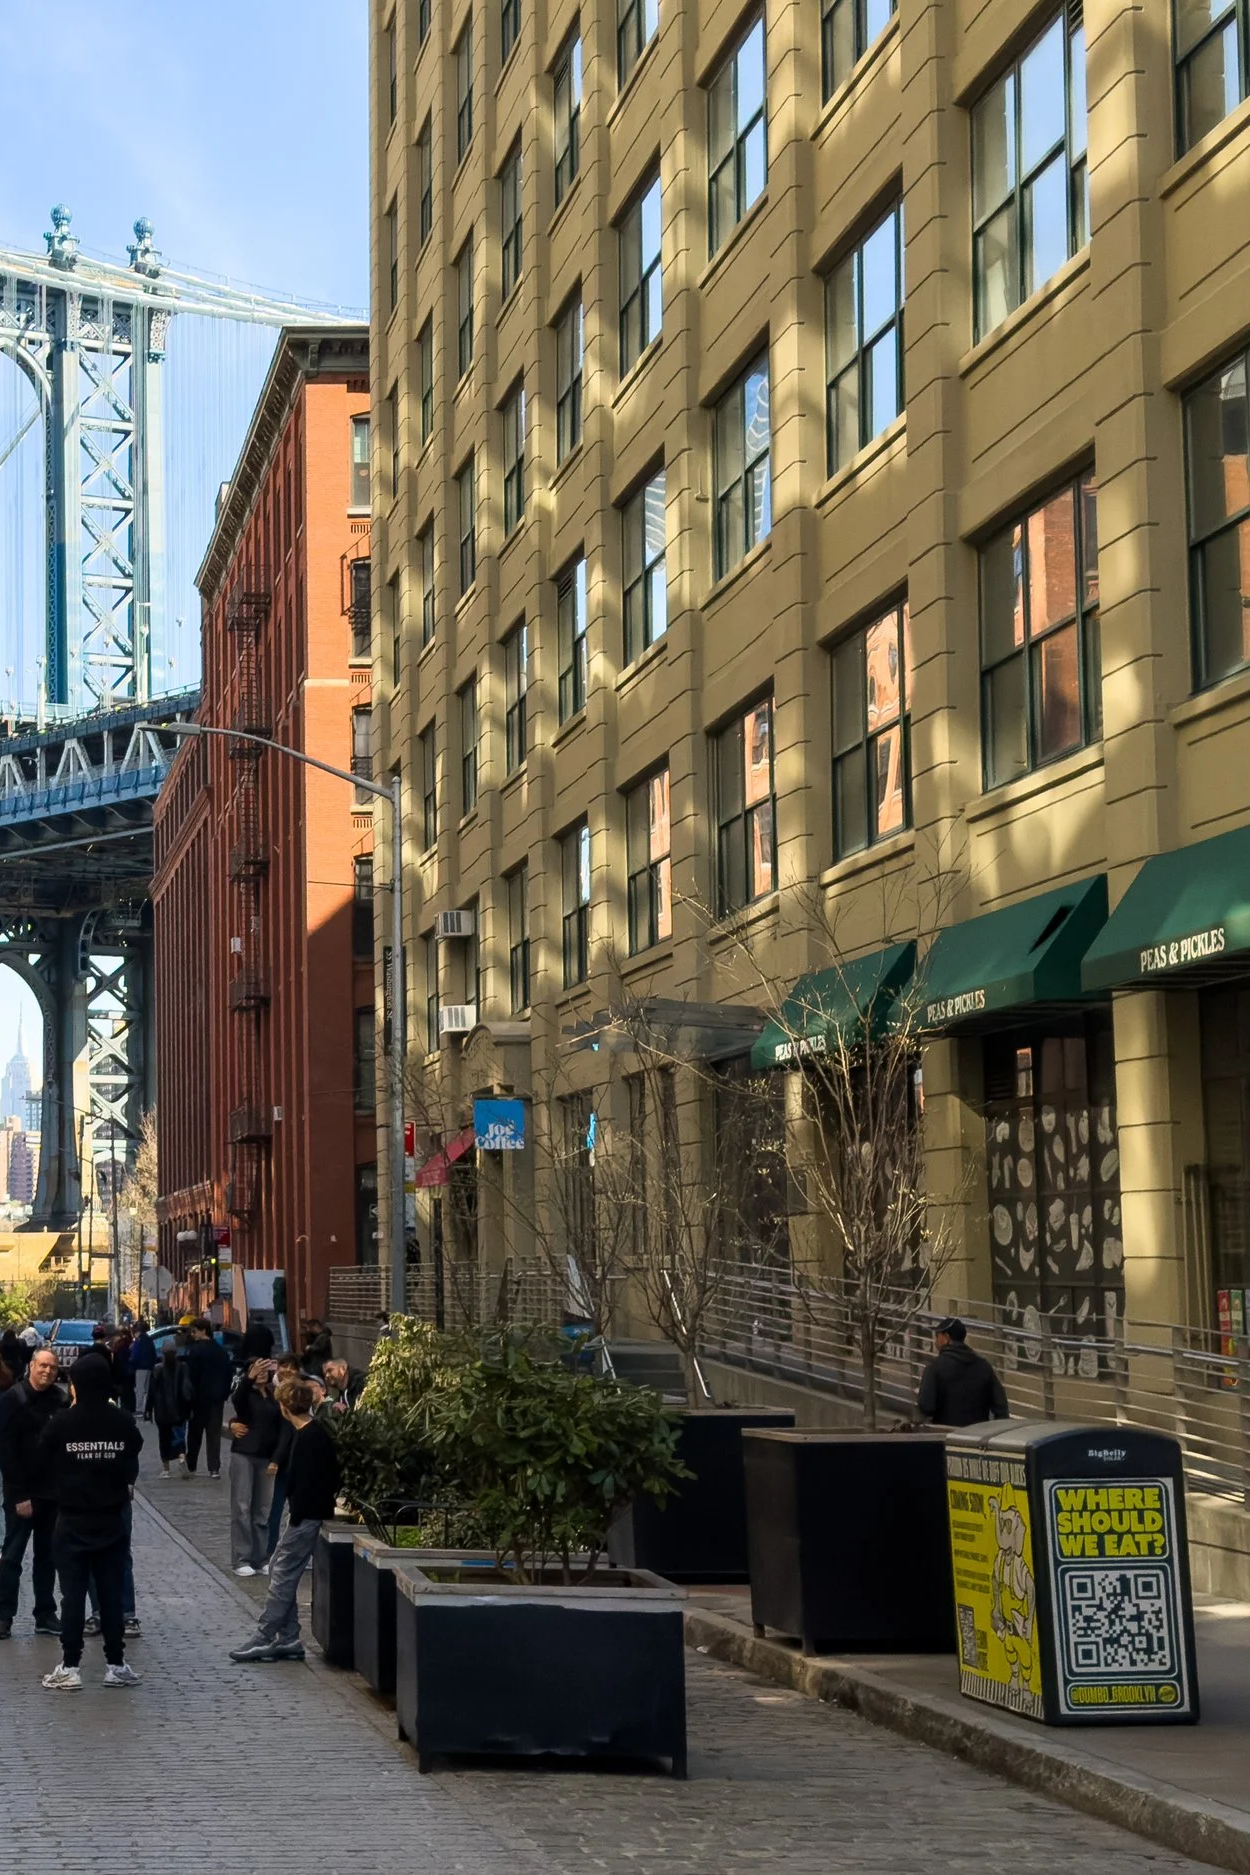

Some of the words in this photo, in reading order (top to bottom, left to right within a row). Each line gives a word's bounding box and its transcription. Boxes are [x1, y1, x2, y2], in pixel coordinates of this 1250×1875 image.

[1140, 945, 1167, 973] PEAS
[1169, 942, 1179, 965] &
[1180, 928, 1225, 962] PICKLES
[927, 1000, 946, 1023] PEAS
[946, 998, 954, 1018] &
[954, 989, 986, 1015] PICKLES
[66, 1441, 125, 1452] ESSENTIALS
[77, 1452, 93, 1460] FEAR
[1056, 1487, 1161, 1511] WHERE
[1057, 1510, 1163, 1534] SHOULD
[1058, 1534, 1099, 1557] WE
[1104, 1533, 1165, 1556] EAT?
